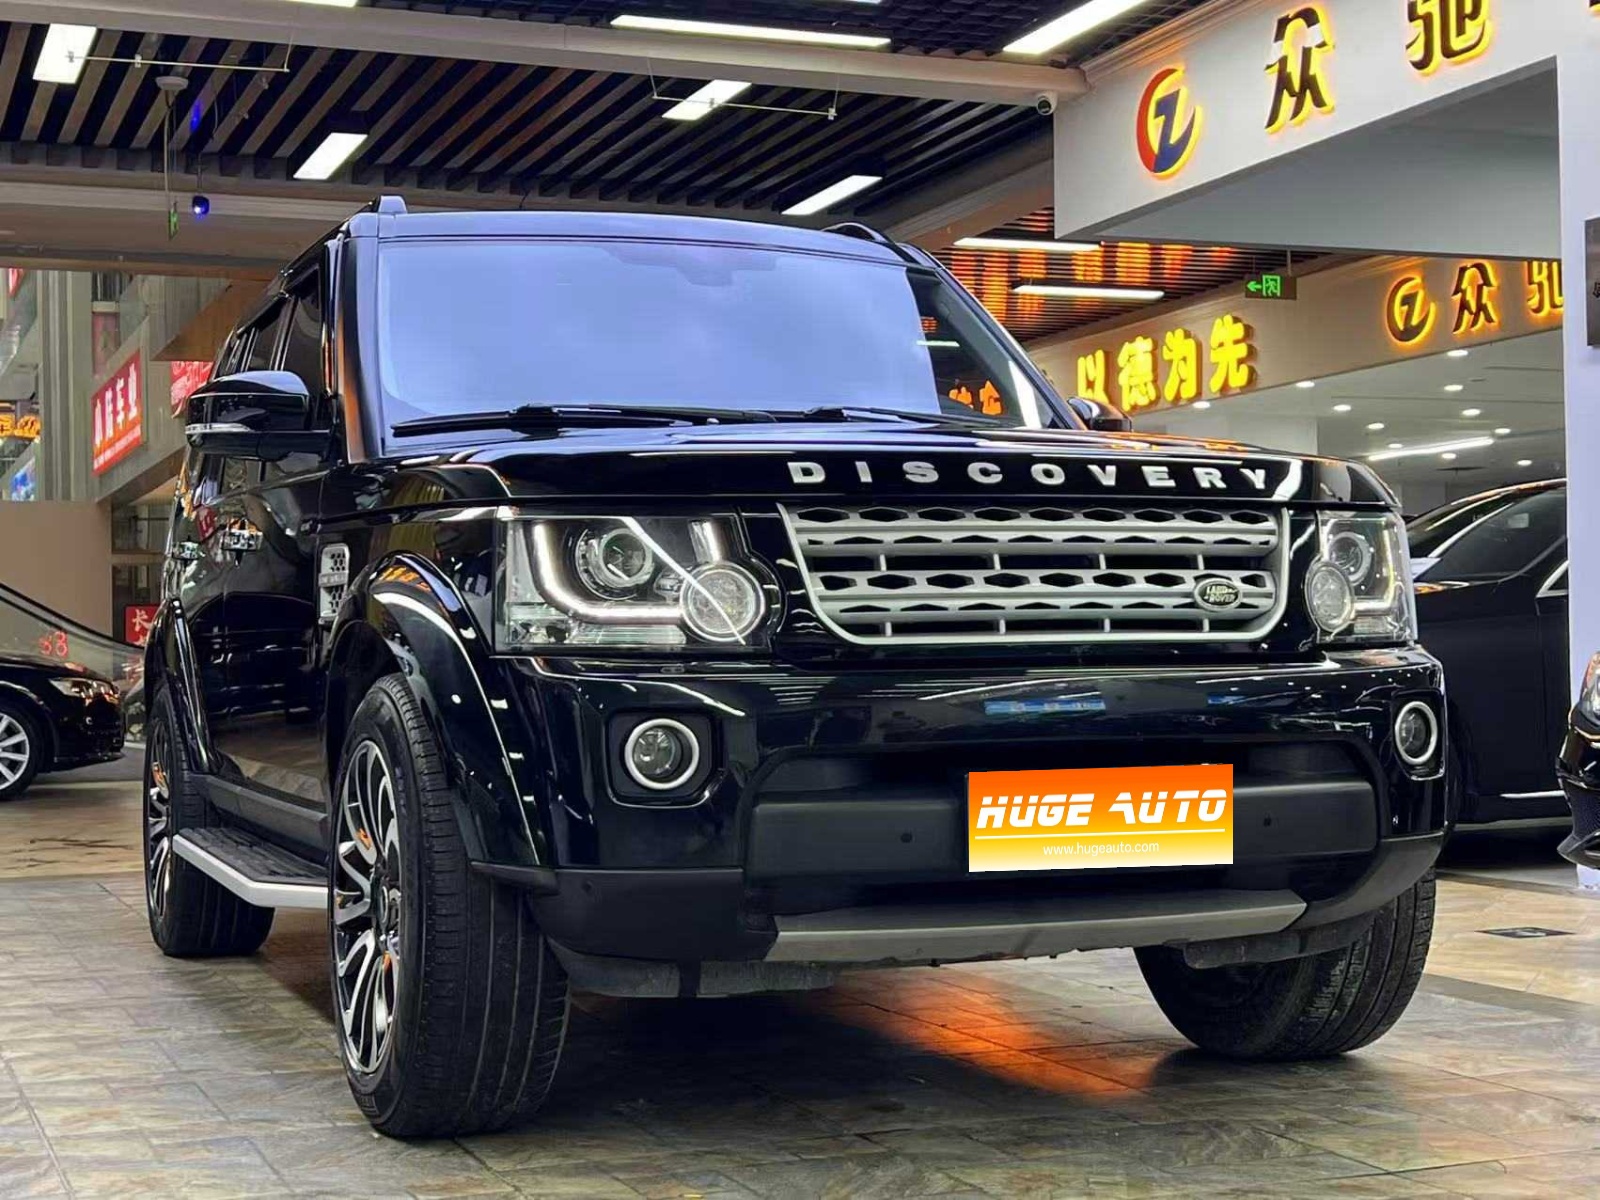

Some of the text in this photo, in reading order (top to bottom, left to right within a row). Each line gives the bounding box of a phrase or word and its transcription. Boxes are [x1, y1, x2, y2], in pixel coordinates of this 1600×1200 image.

[1077, 314, 1249, 412] 以德为先
[787, 461, 1266, 490] DISCOVERY
